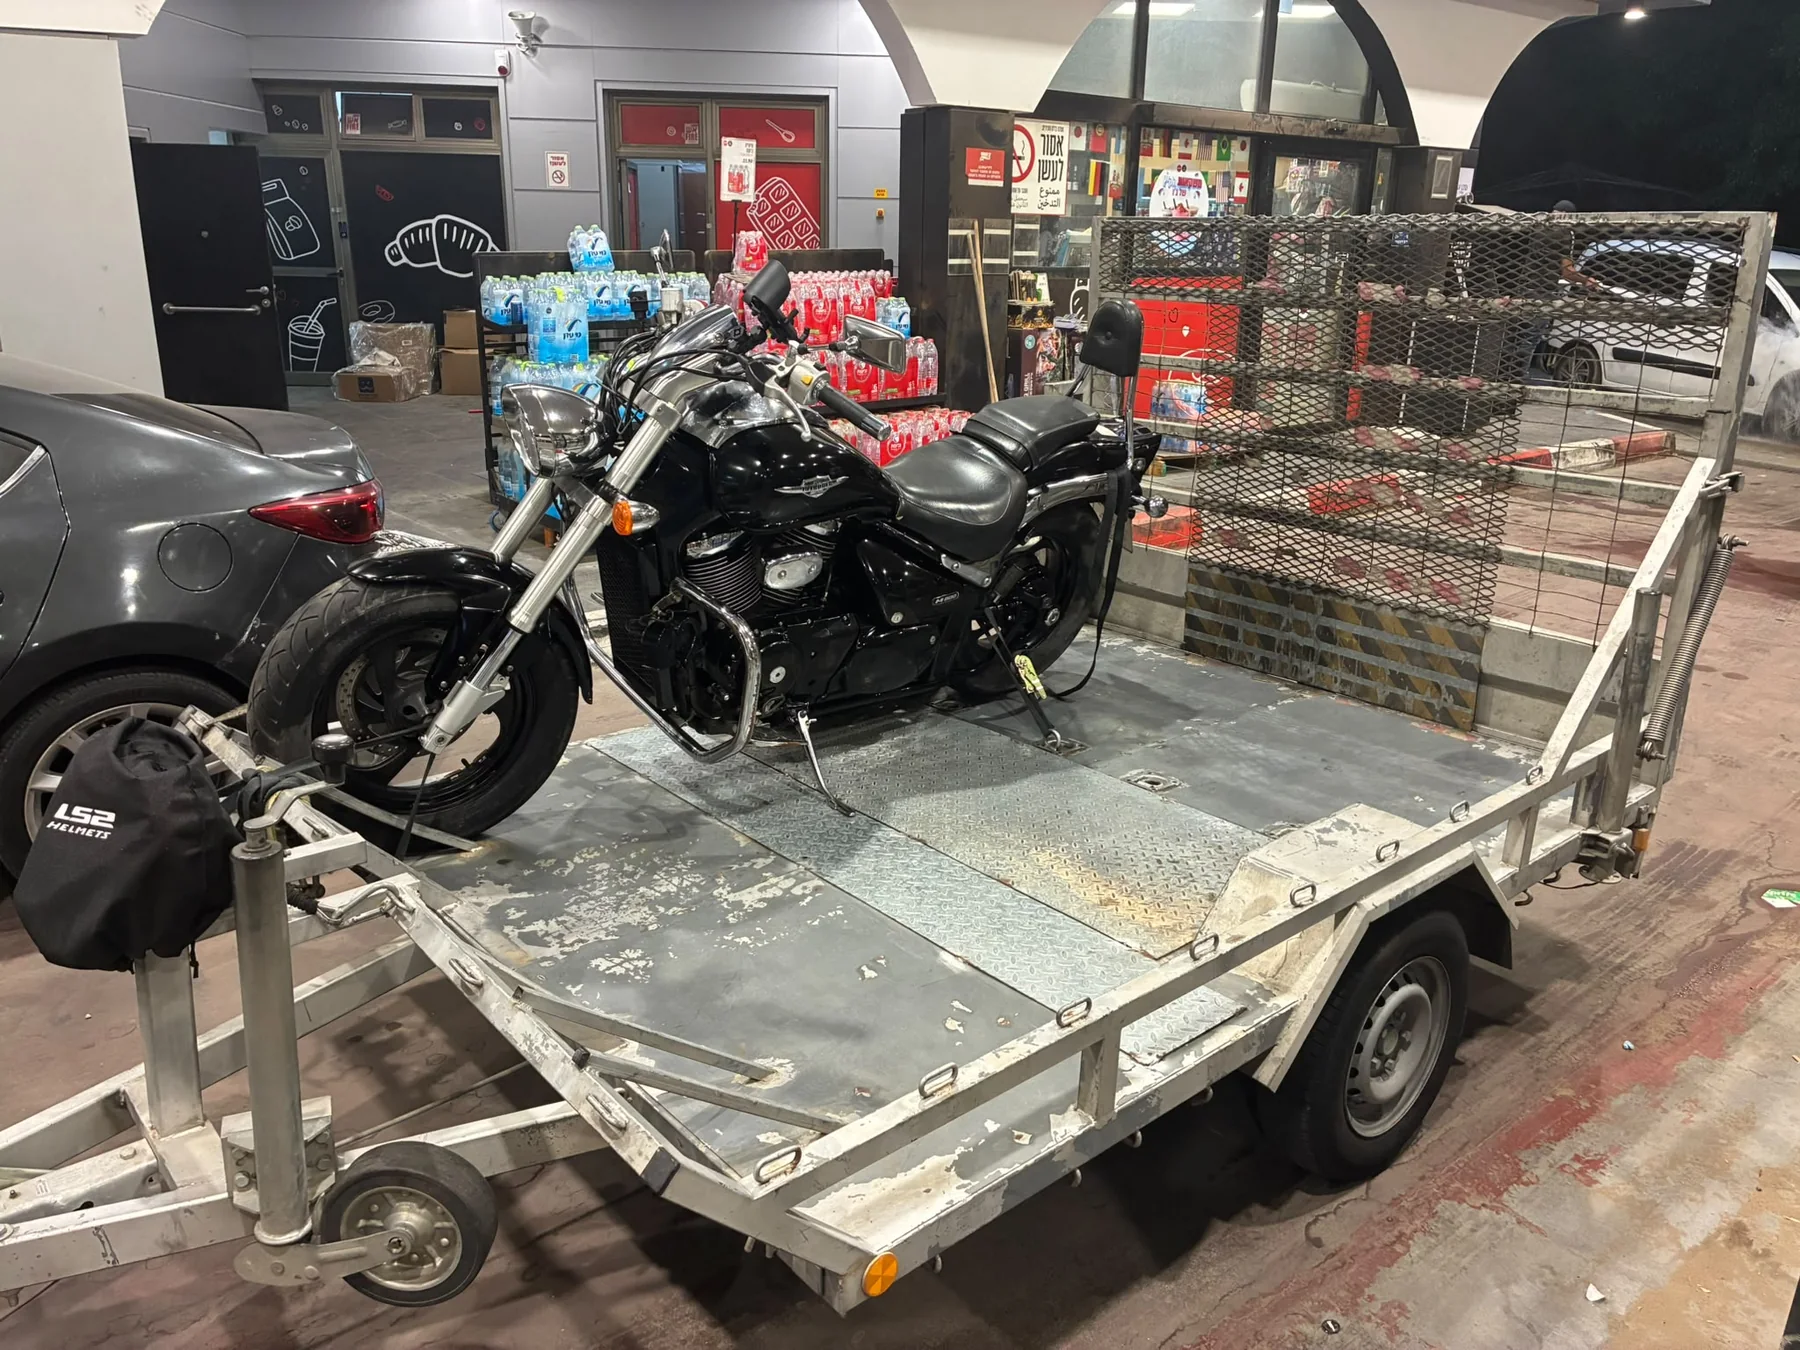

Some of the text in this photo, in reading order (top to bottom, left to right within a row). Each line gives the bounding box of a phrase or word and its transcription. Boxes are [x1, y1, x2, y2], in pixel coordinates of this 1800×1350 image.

[1040, 133, 1064, 156] אסור
[1038, 158, 1064, 183] לעשן
[1039, 186, 1060, 198] ممنوع
[1037, 198, 1061, 210] التدخين
[593, 298, 603, 306] עדן
[563, 332, 574, 340] עדן
[53, 802, 116, 829] LS2
[46, 820, 112, 840] HELMETS
